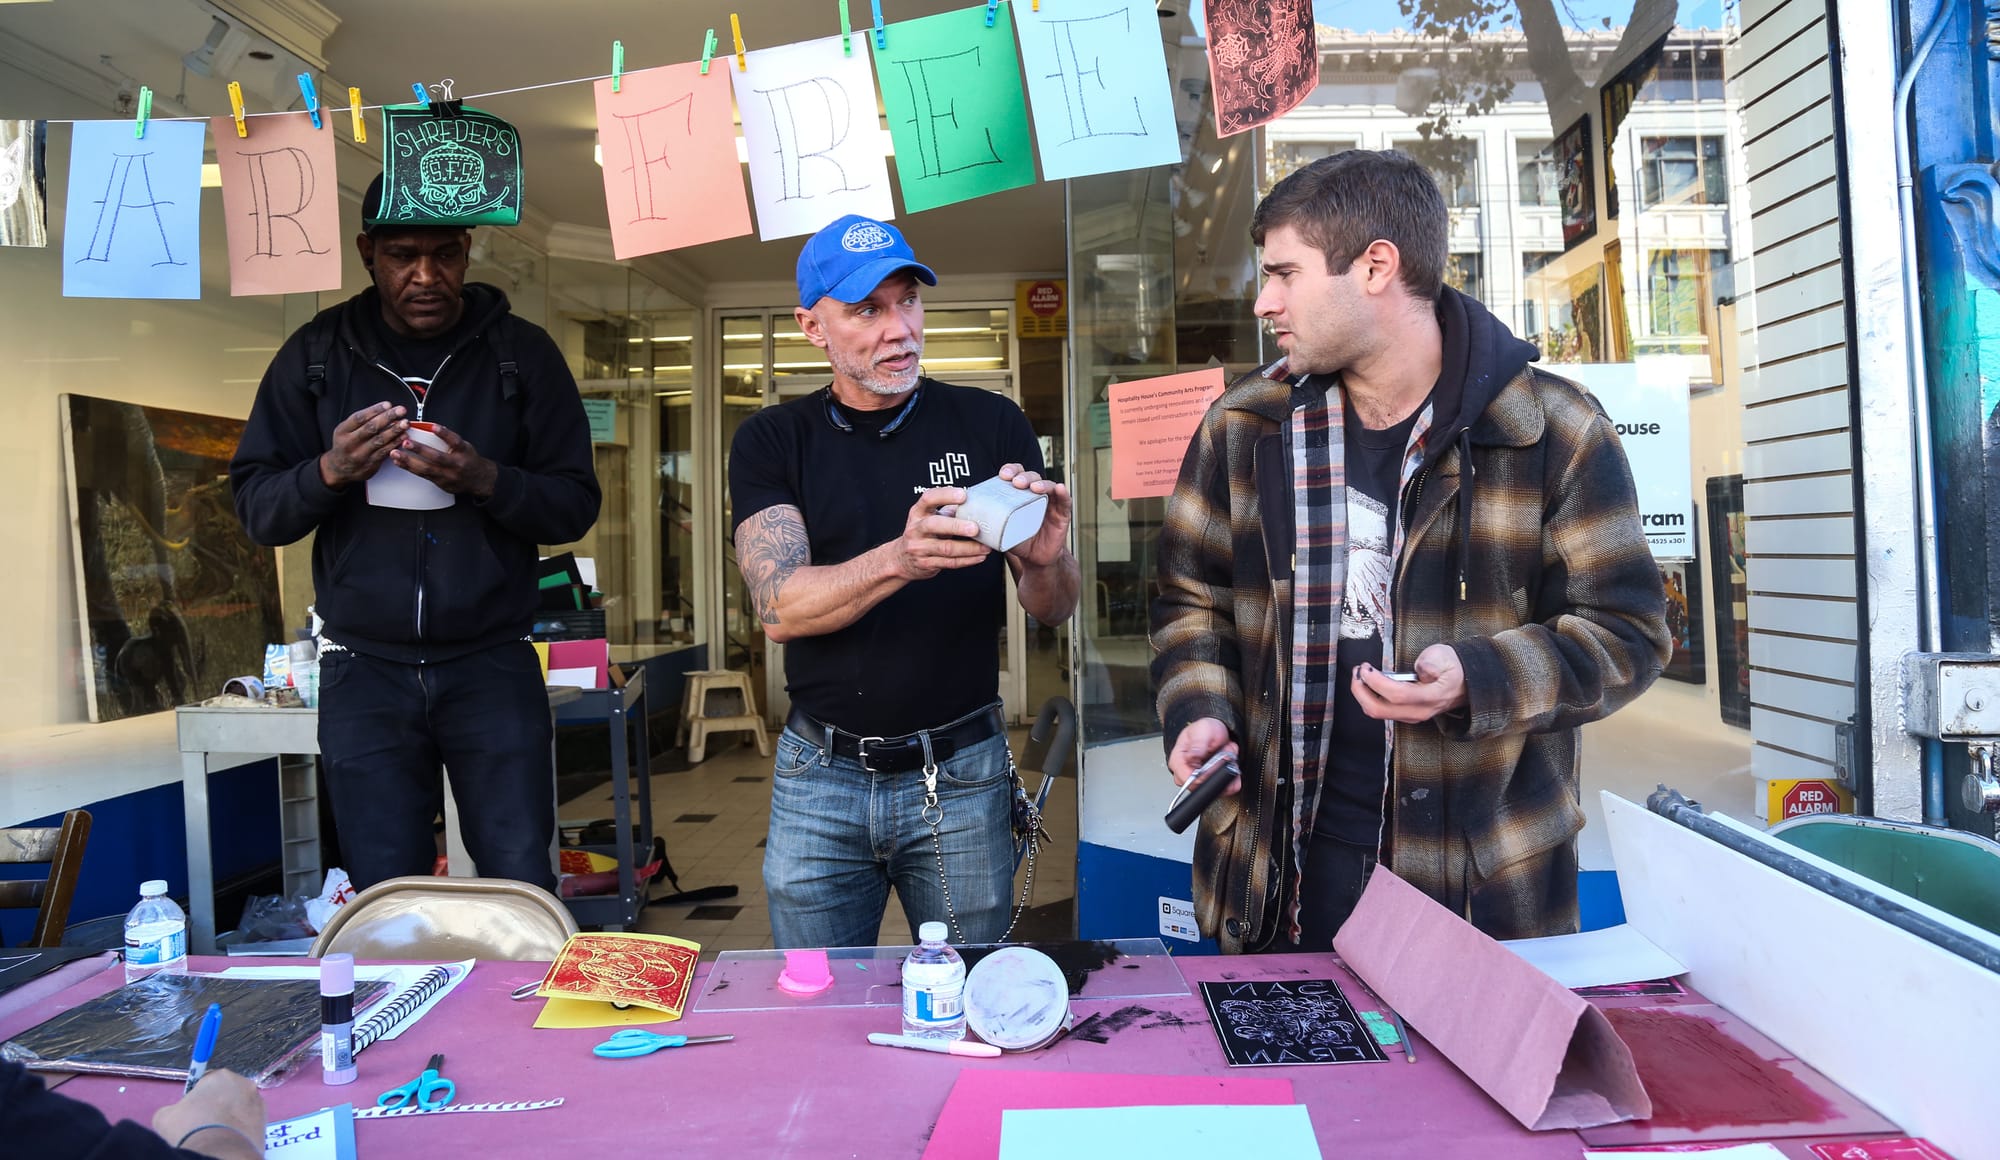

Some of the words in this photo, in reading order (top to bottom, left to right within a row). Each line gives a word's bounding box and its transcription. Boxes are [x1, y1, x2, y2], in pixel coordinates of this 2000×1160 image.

[394, 119, 514, 157] SHREDERS
[1037, 287, 1054, 295] RED
[1031, 294, 1060, 302] ALARM
[1158, 388, 1183, 398] Community
[1614, 422, 1661, 435] ouse
[1641, 513, 1685, 526] ram
[1799, 790, 1824, 802] RED
[1788, 802, 1834, 814] ALARM
[1172, 906, 1197, 918] Square
